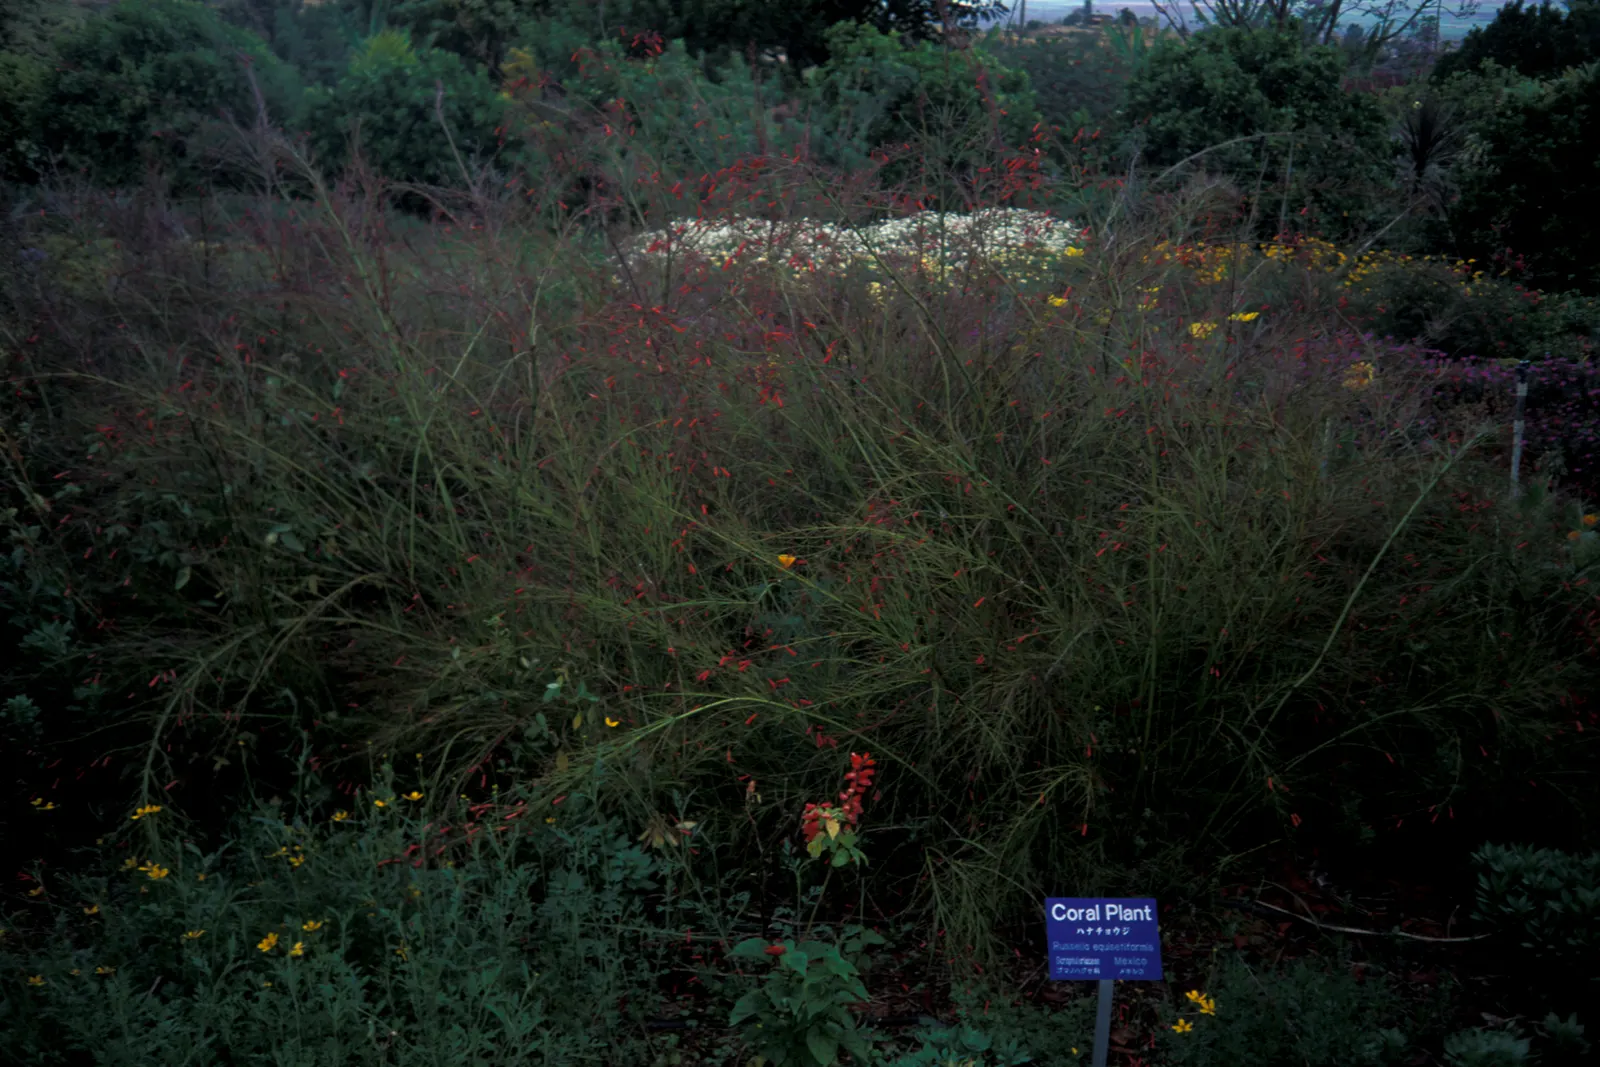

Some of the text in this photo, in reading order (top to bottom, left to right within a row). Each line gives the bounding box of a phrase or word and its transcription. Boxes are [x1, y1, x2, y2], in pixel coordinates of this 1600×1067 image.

[1052, 904, 1152, 921] Coral Plant
[1077, 927, 1130, 936] ハナチョウジ
[1114, 957, 1148, 966] Mexico
